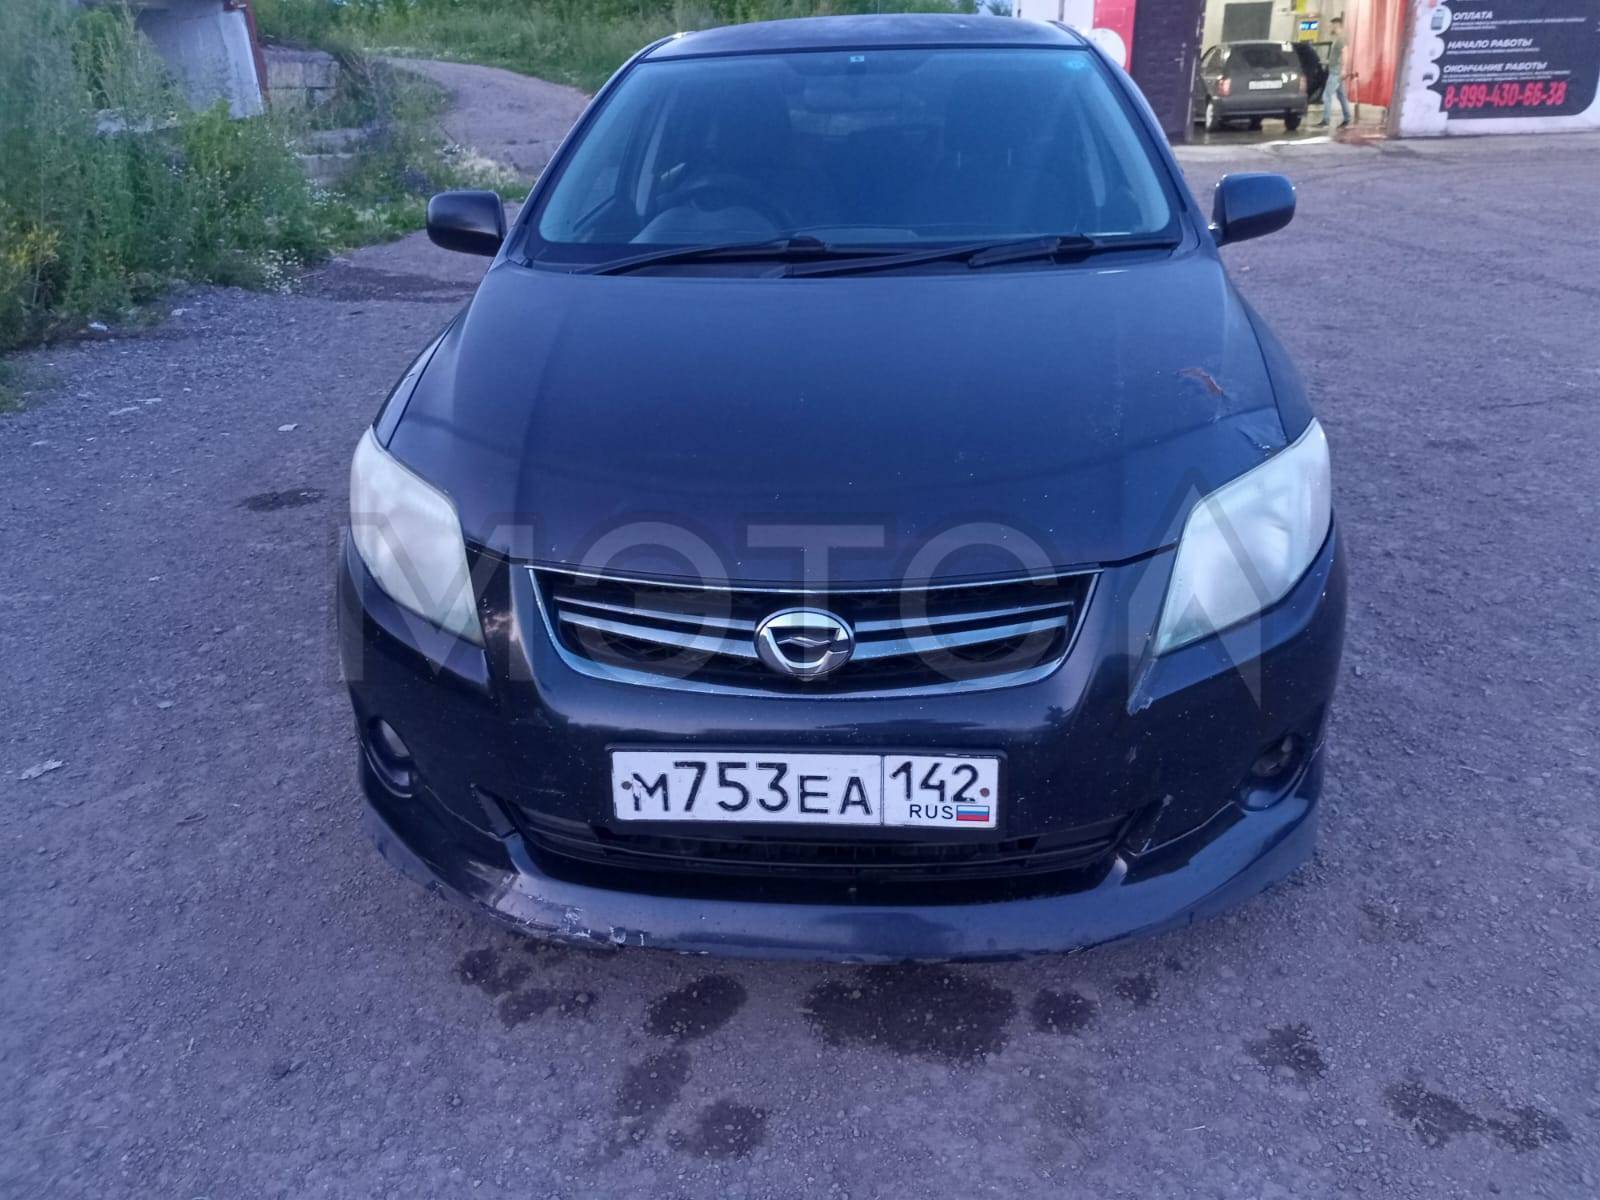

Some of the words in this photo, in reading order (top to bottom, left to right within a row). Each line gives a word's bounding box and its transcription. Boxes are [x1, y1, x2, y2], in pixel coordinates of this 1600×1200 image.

[1452, 11, 1493, 21] ОПЛАТА
[1447, 40, 1489, 50] НАЧАЛО
[1490, 38, 1533, 48] РАБОТЫ
[1443, 63, 1503, 73] ОКОНЧАНИЕ
[1504, 62, 1548, 71] РАБОТЫ
[889, 760, 980, 803] 142
[908, 804, 954, 820] RUS
